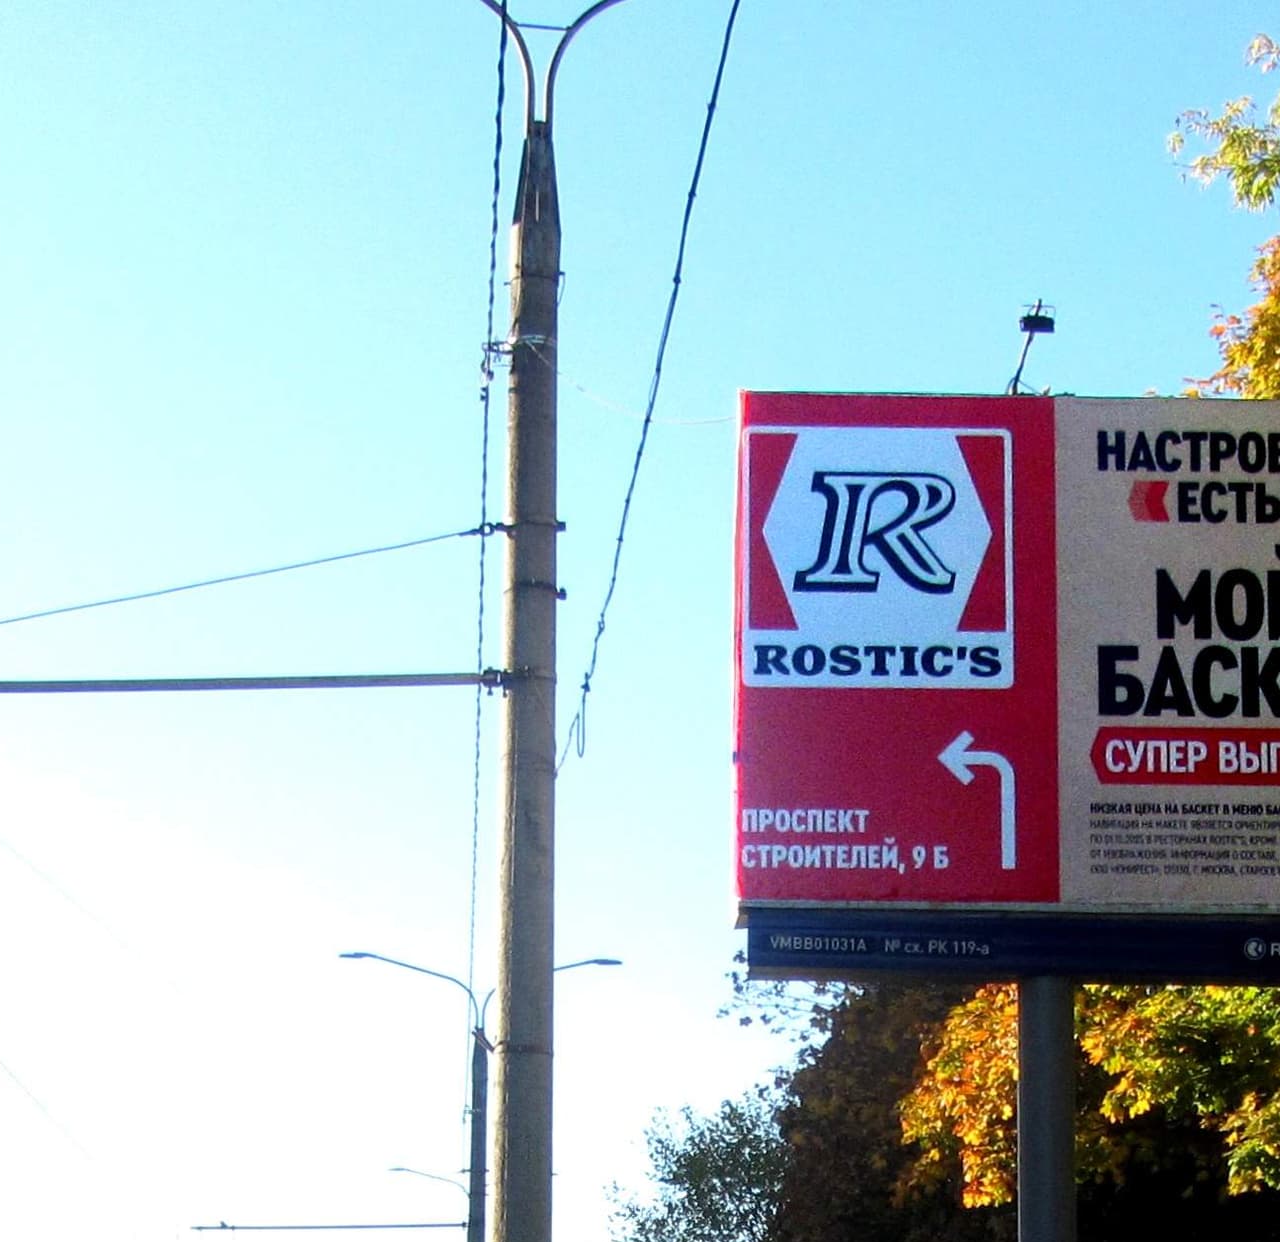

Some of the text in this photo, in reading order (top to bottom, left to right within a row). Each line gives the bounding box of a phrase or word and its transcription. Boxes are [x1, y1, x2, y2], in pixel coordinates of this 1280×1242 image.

[753, 644, 1002, 678] ROSTIC'S
[1104, 738, 1208, 774] СУПЕР
[742, 809, 869, 833] ПРОСПЕКТ
[1090, 803, 1132, 814] НИЗКАЯ
[1135, 803, 1161, 816] ЦЕНА
[1165, 803, 1178, 814] НА
[1181, 804, 1220, 815] БАСКЕТ
[1223, 804, 1230, 815] В
[1232, 804, 1263, 816] МЕНЮ
[741, 837, 950, 874] СТРОИТЕЛЕЙ, 9 Б
